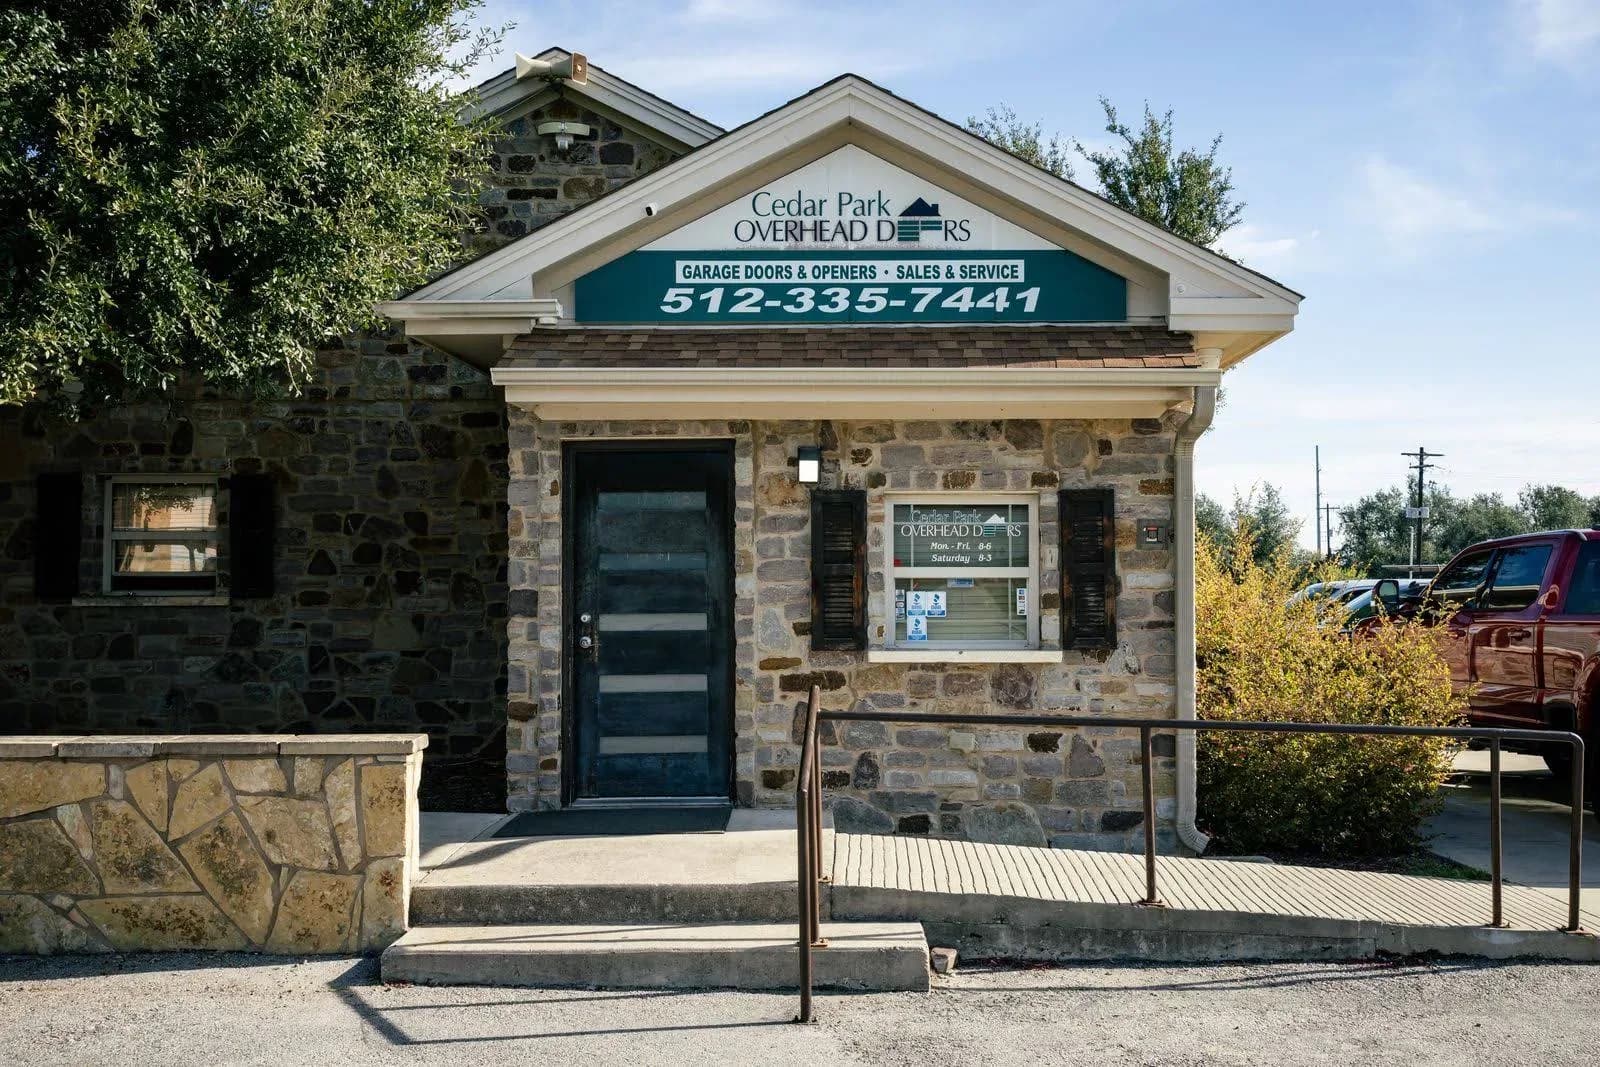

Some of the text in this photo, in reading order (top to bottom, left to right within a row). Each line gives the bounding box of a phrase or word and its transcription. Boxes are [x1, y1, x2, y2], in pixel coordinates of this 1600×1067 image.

[752, 190, 891, 217] Cedar Park
[734, 219, 971, 242] OVERHEAD DRS
[682, 264, 1019, 280] GARAGE DOORS & OPENERS SALES & SERVICE
[660, 287, 1041, 314] 512-335-7441
[910, 509, 982, 524] Cedar Park
[901, 524, 1022, 537] OVERHEAD DRS
[931, 553, 971, 563] Saturday
